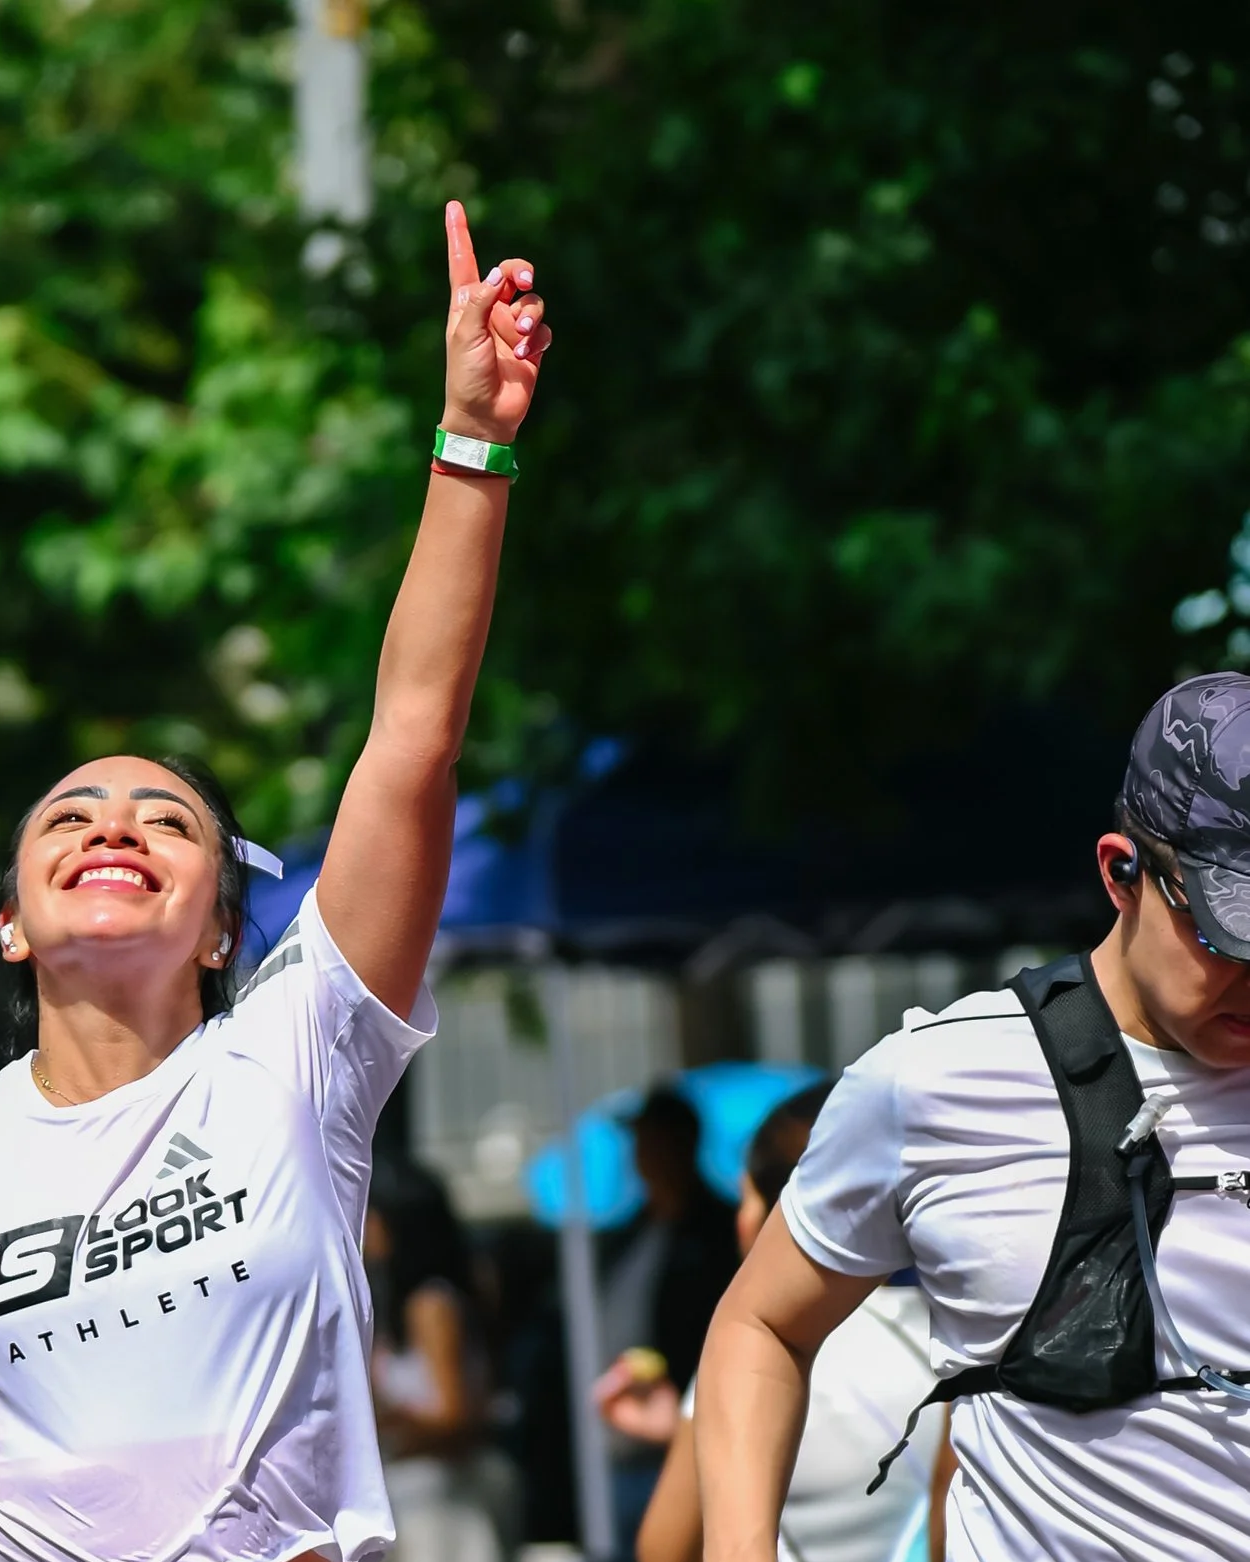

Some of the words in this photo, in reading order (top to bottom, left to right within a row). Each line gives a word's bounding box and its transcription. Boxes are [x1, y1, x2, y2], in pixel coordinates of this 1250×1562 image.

[84, 1188, 248, 1282] SPORT
[87, 1169, 216, 1244] LOOK
[8, 1260, 251, 1364] ATHLETE
